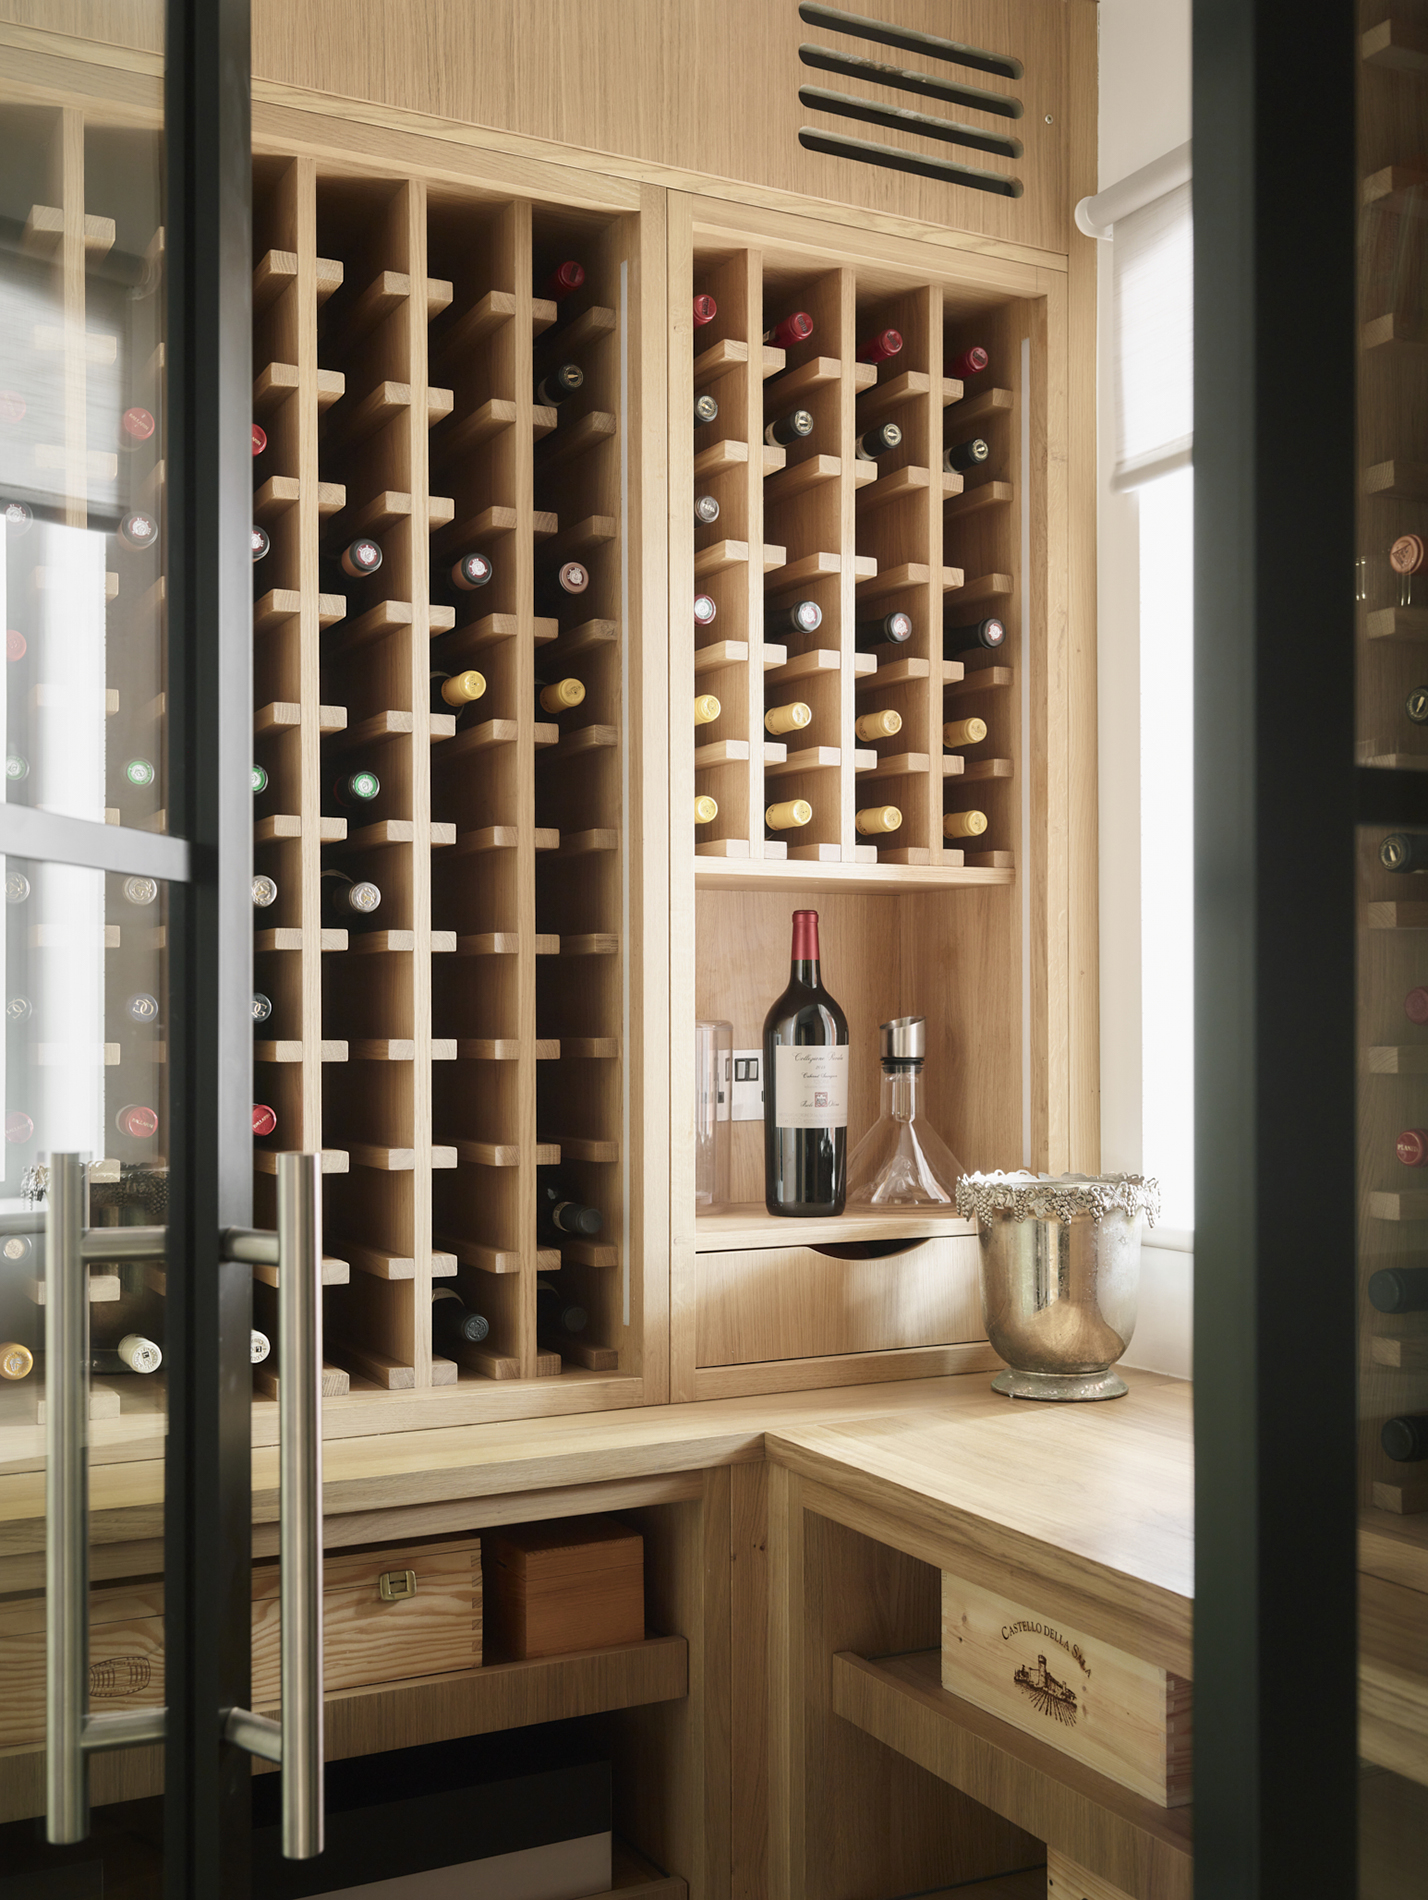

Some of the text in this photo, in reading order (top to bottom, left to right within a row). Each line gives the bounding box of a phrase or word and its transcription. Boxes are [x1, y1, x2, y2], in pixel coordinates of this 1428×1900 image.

[1001, 1621, 1091, 1678] CASTELLO DELLA SALA
